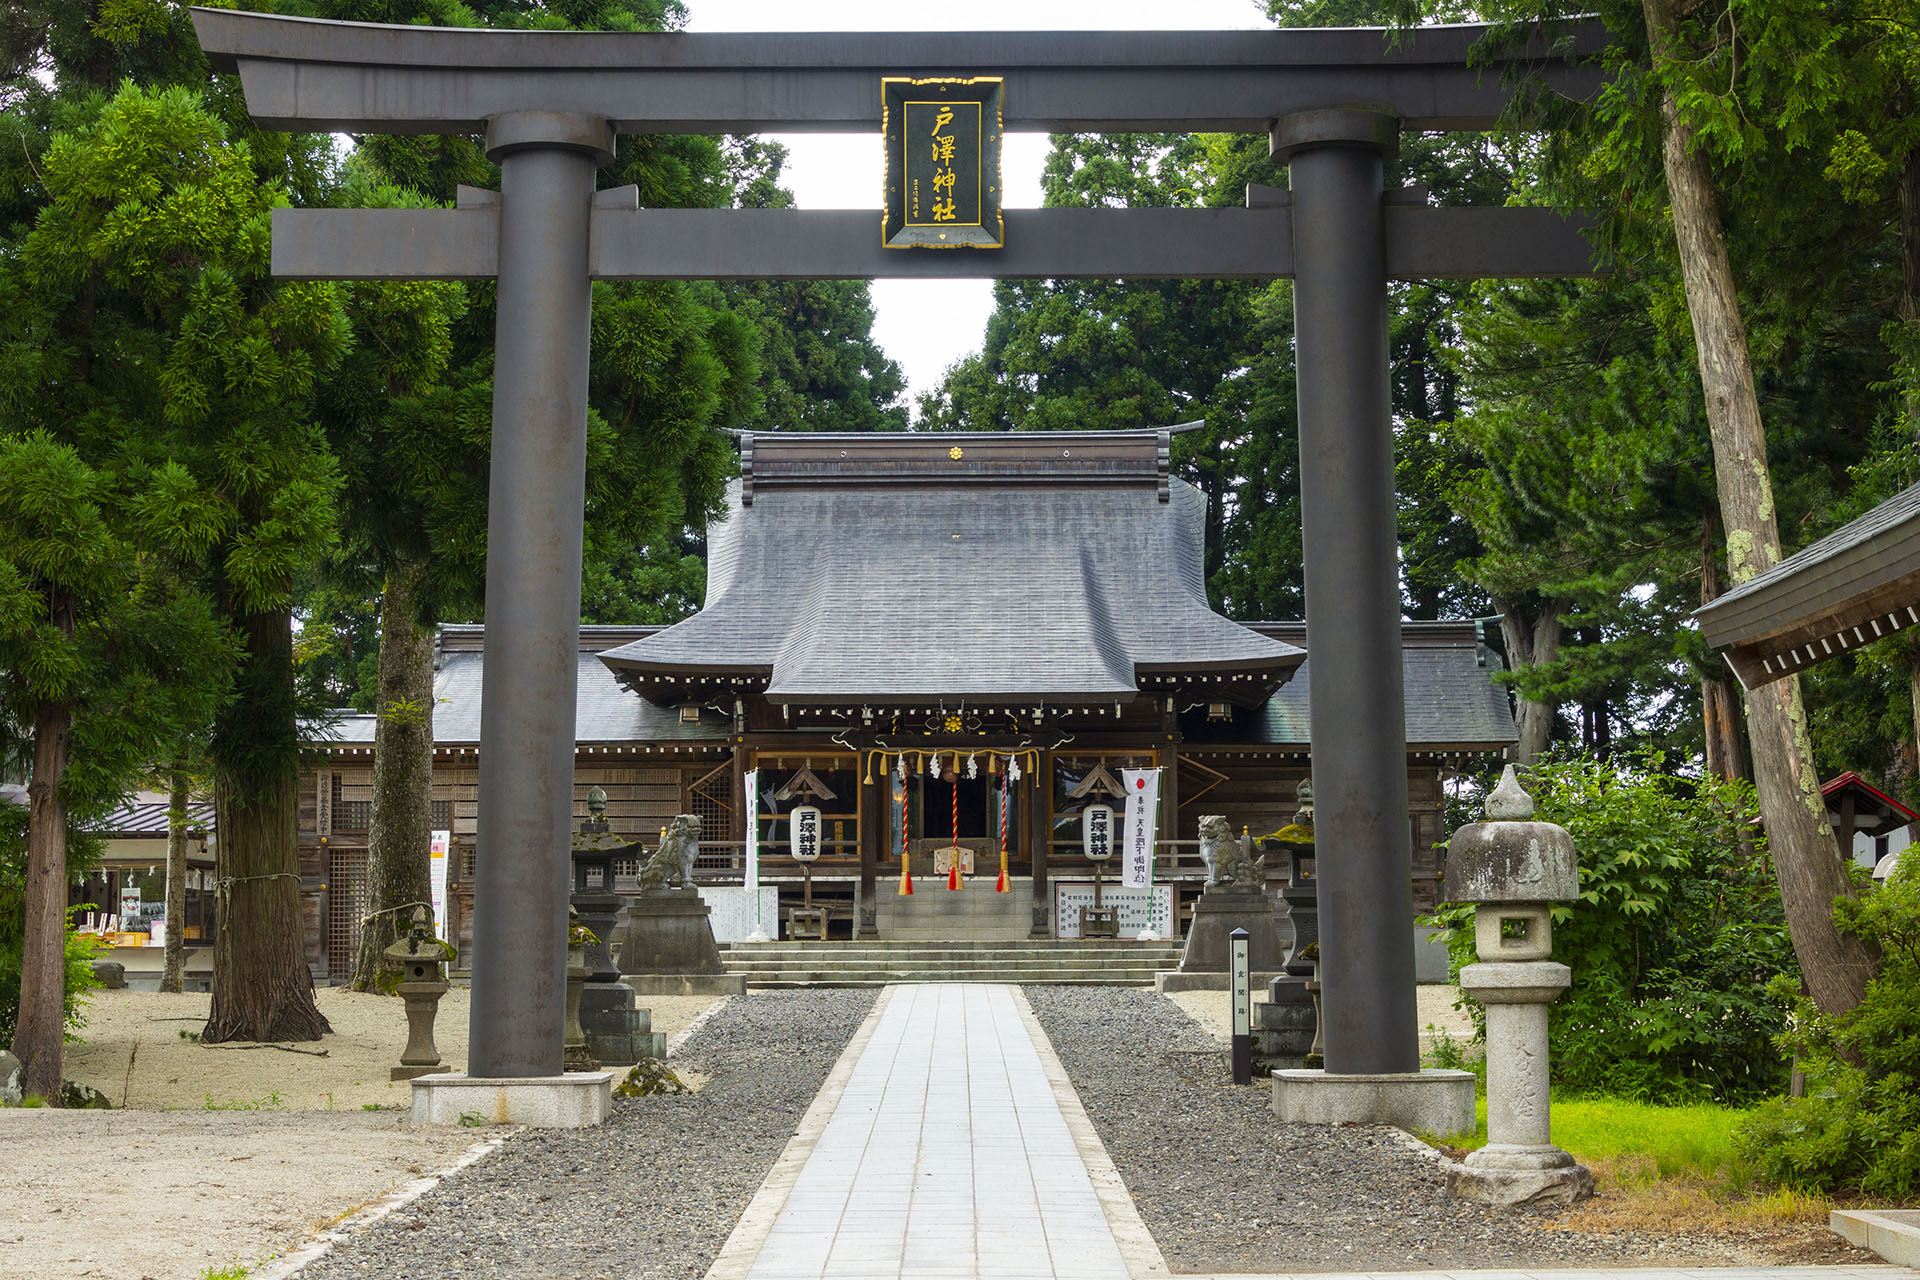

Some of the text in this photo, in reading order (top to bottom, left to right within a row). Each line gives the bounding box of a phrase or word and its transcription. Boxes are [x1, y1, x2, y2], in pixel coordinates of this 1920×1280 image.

[799, 811, 816, 855] 戸澤神社
[1090, 810, 1108, 855] 戸澤神社
